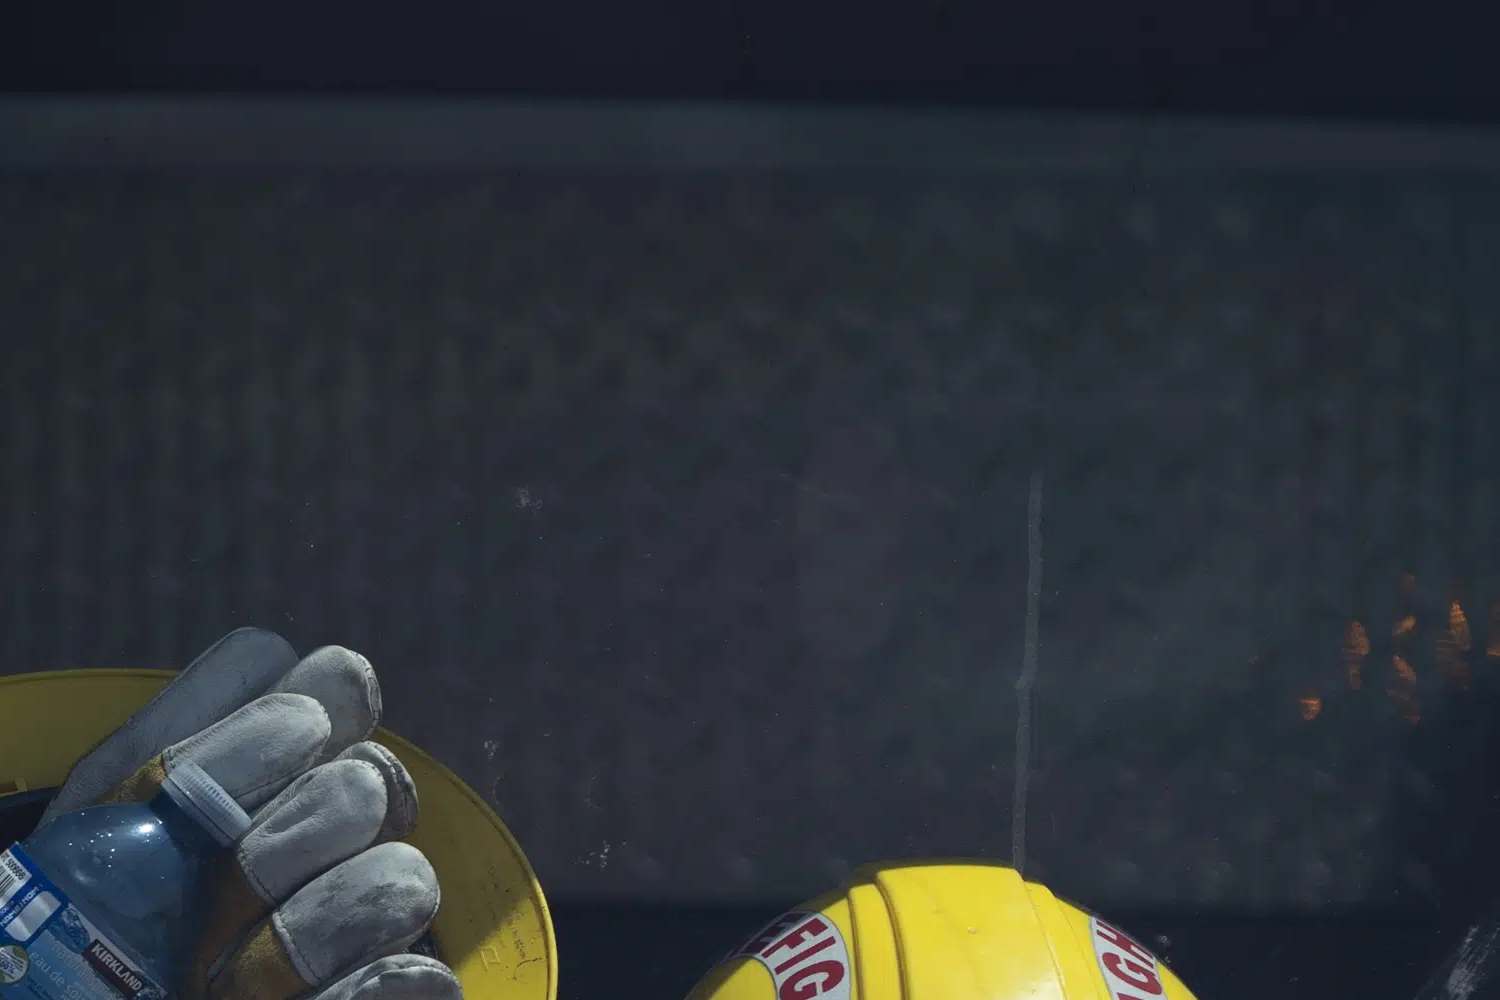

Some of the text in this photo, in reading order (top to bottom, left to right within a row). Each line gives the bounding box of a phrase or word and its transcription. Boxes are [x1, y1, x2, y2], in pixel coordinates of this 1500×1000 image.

[27, 950, 51, 974] eau
[48, 967, 68, 988] de
[90, 942, 143, 992] KIRKLAND
